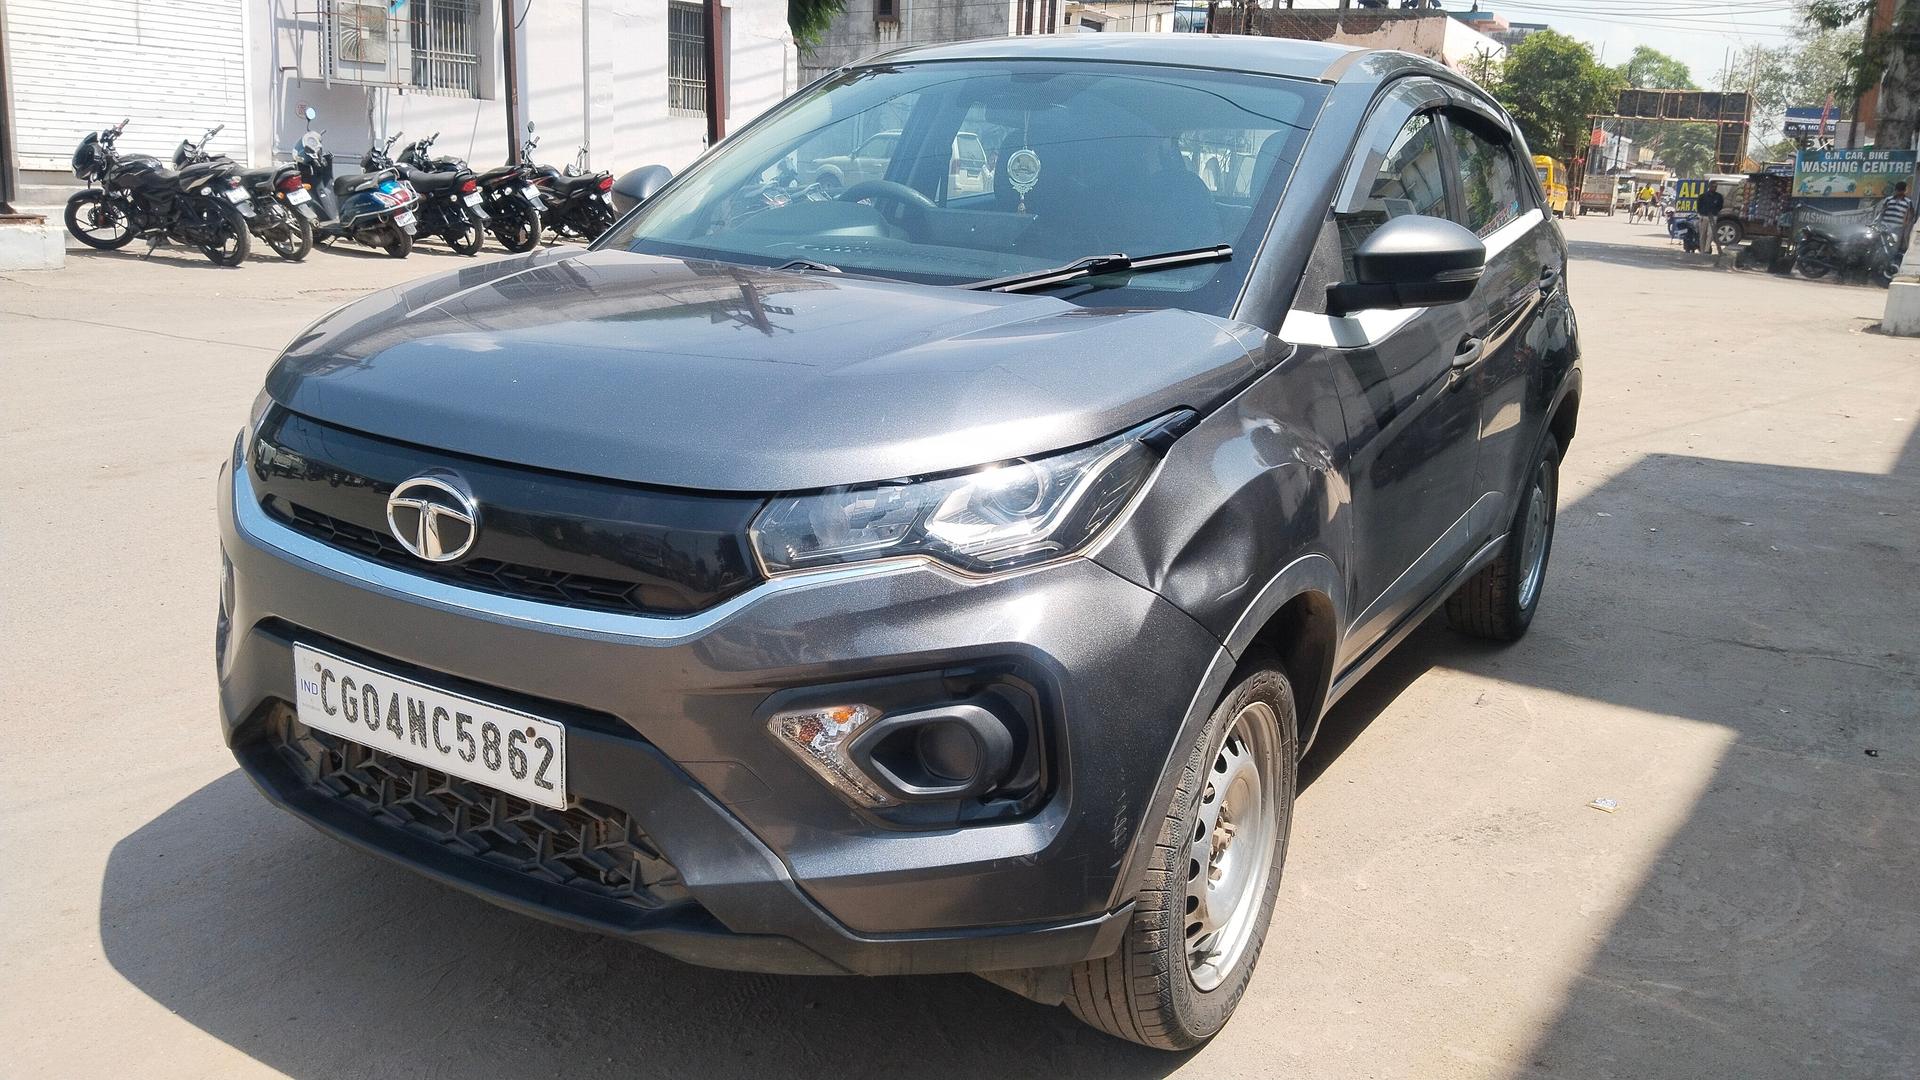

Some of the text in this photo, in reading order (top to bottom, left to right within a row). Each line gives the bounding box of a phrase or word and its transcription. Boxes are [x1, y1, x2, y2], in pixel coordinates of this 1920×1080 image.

[1825, 151, 1842, 160] G.N.
[1868, 151, 1890, 160] BIKE
[1801, 161, 1858, 173] WASHING
[1862, 161, 1913, 173] CENTRE
[1676, 200, 1691, 211] CAR
[300, 668, 555, 790] IND CG04NC5862
